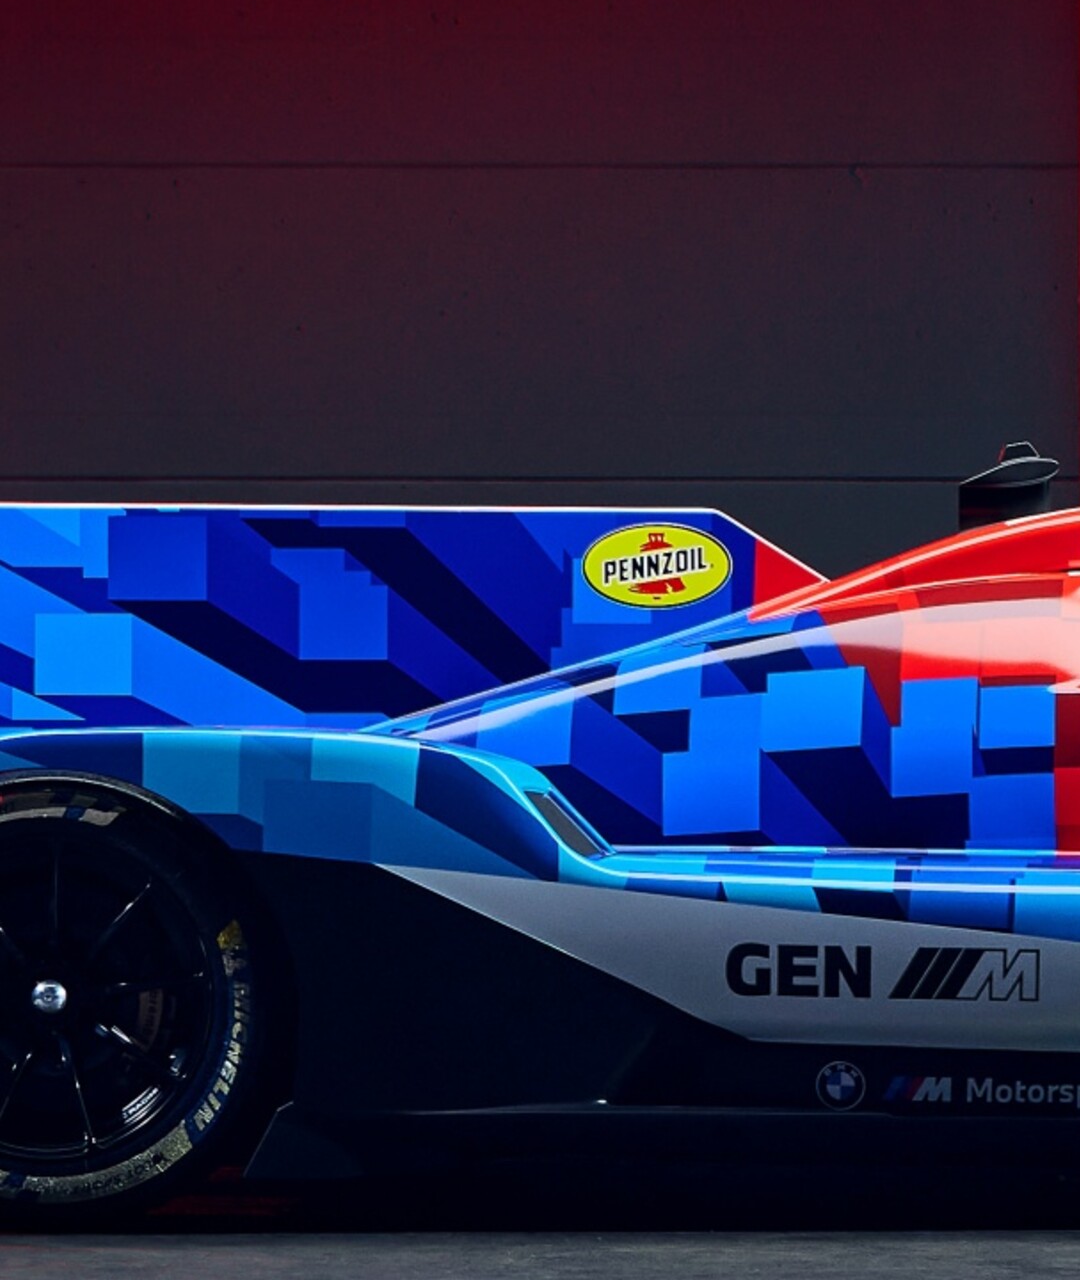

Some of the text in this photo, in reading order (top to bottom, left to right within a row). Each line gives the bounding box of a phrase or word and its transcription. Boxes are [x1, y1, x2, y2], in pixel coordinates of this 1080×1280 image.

[604, 547, 707, 584] PENNZOIL
[726, 942, 872, 999] GEN
[192, 982, 251, 1133] MICHELIN
